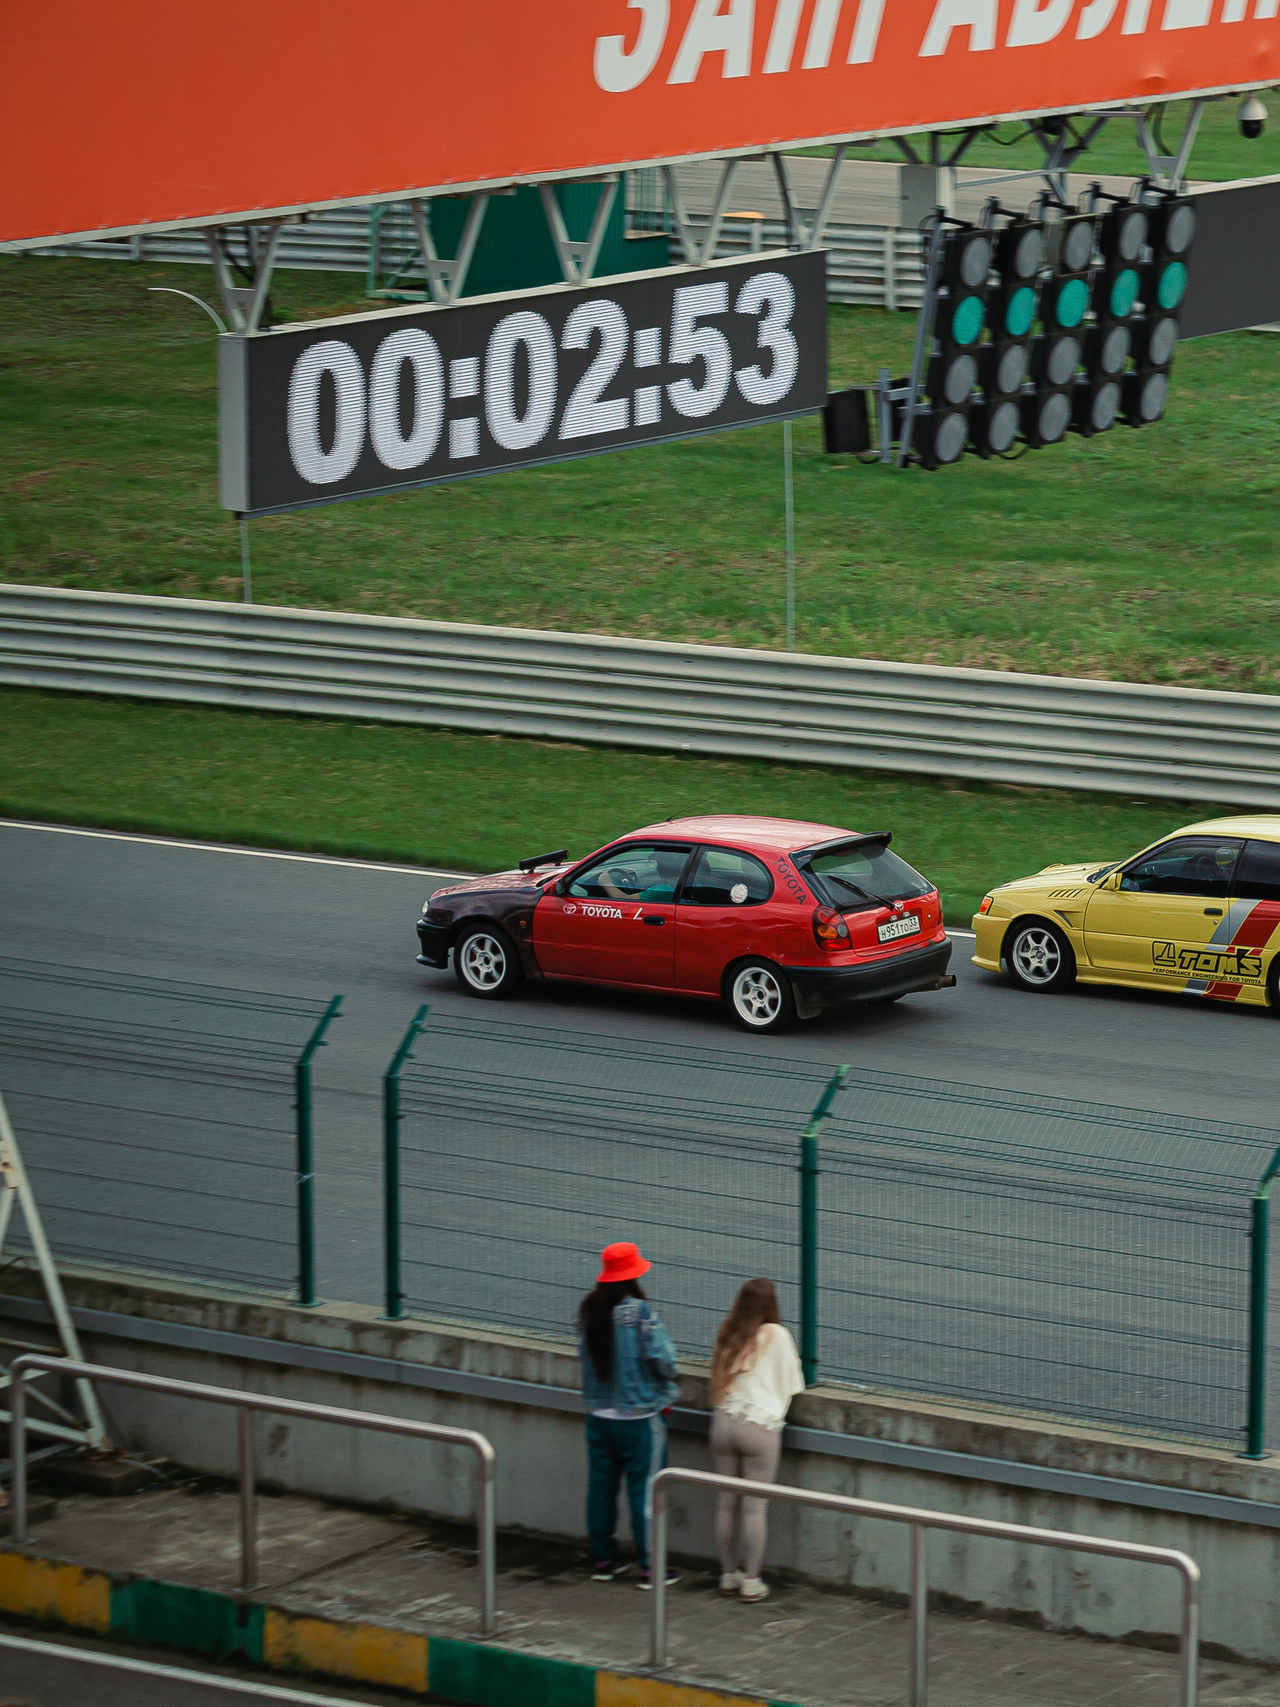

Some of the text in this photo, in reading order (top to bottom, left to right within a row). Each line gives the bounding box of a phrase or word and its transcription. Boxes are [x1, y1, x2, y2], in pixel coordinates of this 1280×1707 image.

[286, 271, 800, 485] 00:02:53
[774, 856, 807, 905] TOYOTA
[581, 906, 622, 919] TOYOTA
[1152, 967, 1191, 976] PERFORMANCE
[1192, 972, 1228, 981] ENGINEERING
[1241, 977, 1262, 985] TOYOTA
